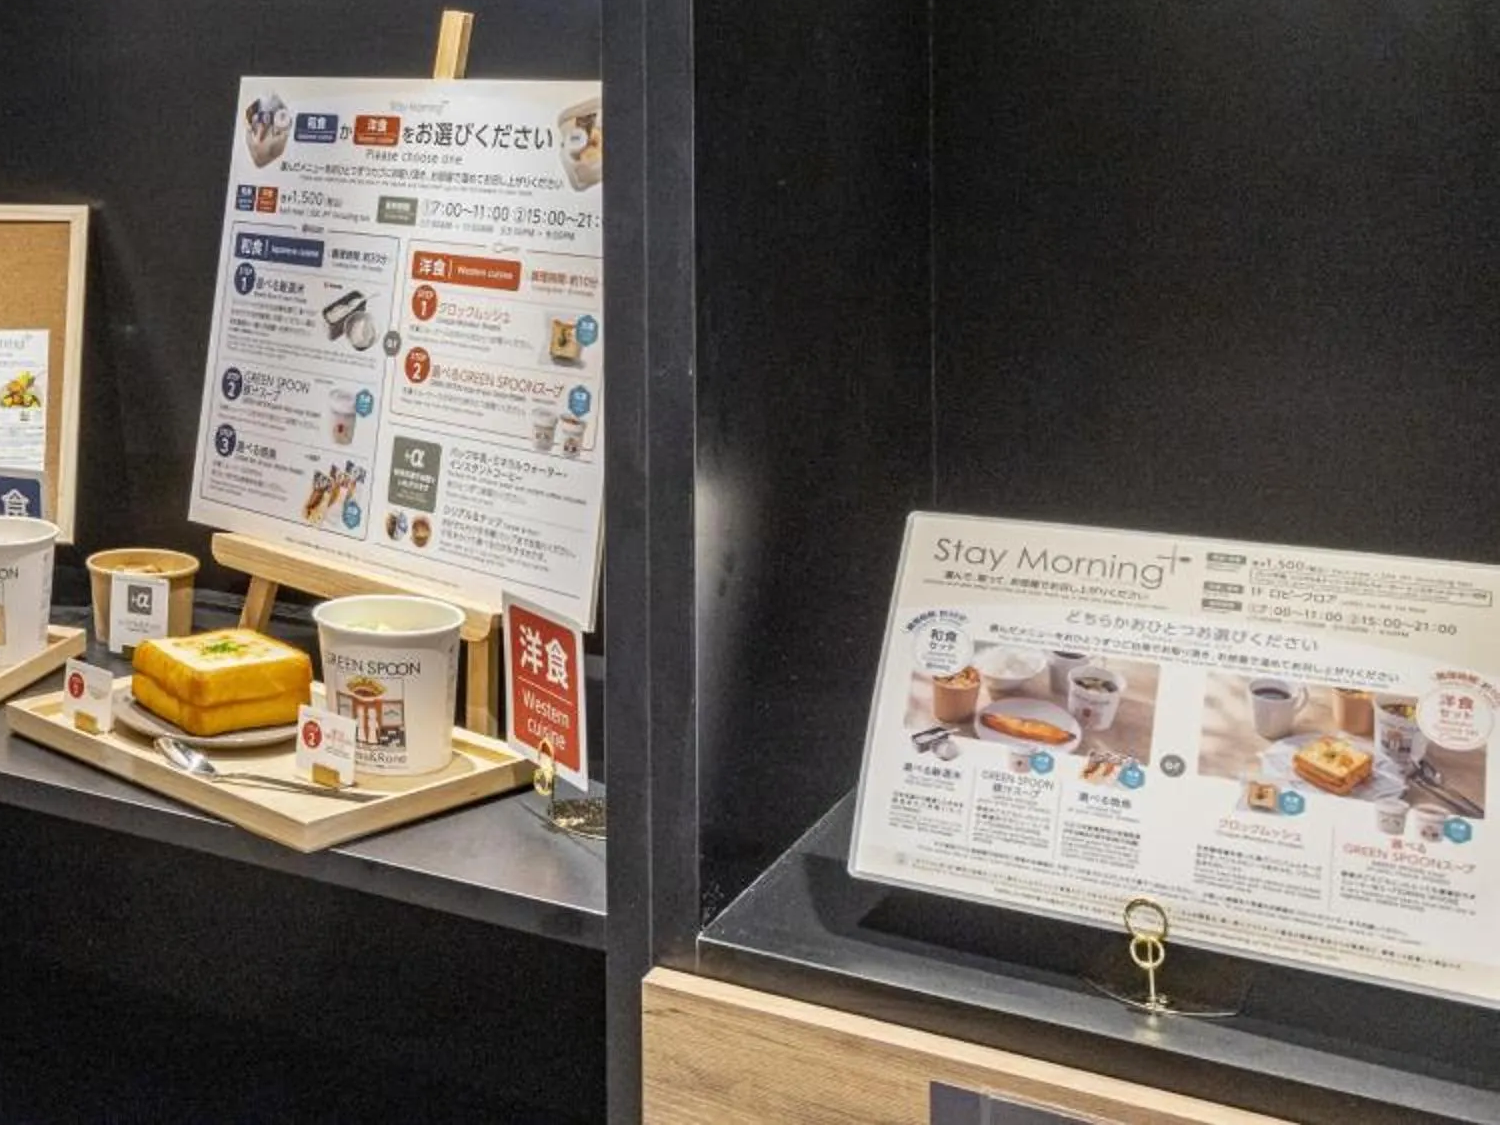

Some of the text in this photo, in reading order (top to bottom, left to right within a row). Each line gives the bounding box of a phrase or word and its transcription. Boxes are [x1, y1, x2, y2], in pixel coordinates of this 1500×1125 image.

[419, 258, 446, 277] 洋食
[412, 362, 422, 380] 2
[933, 537, 1008, 572] Stay
[1016, 546, 1165, 590] Morning
[367, 660, 422, 676] SPOON
[518, 624, 569, 690] 洋食
[522, 688, 570, 729] Western
